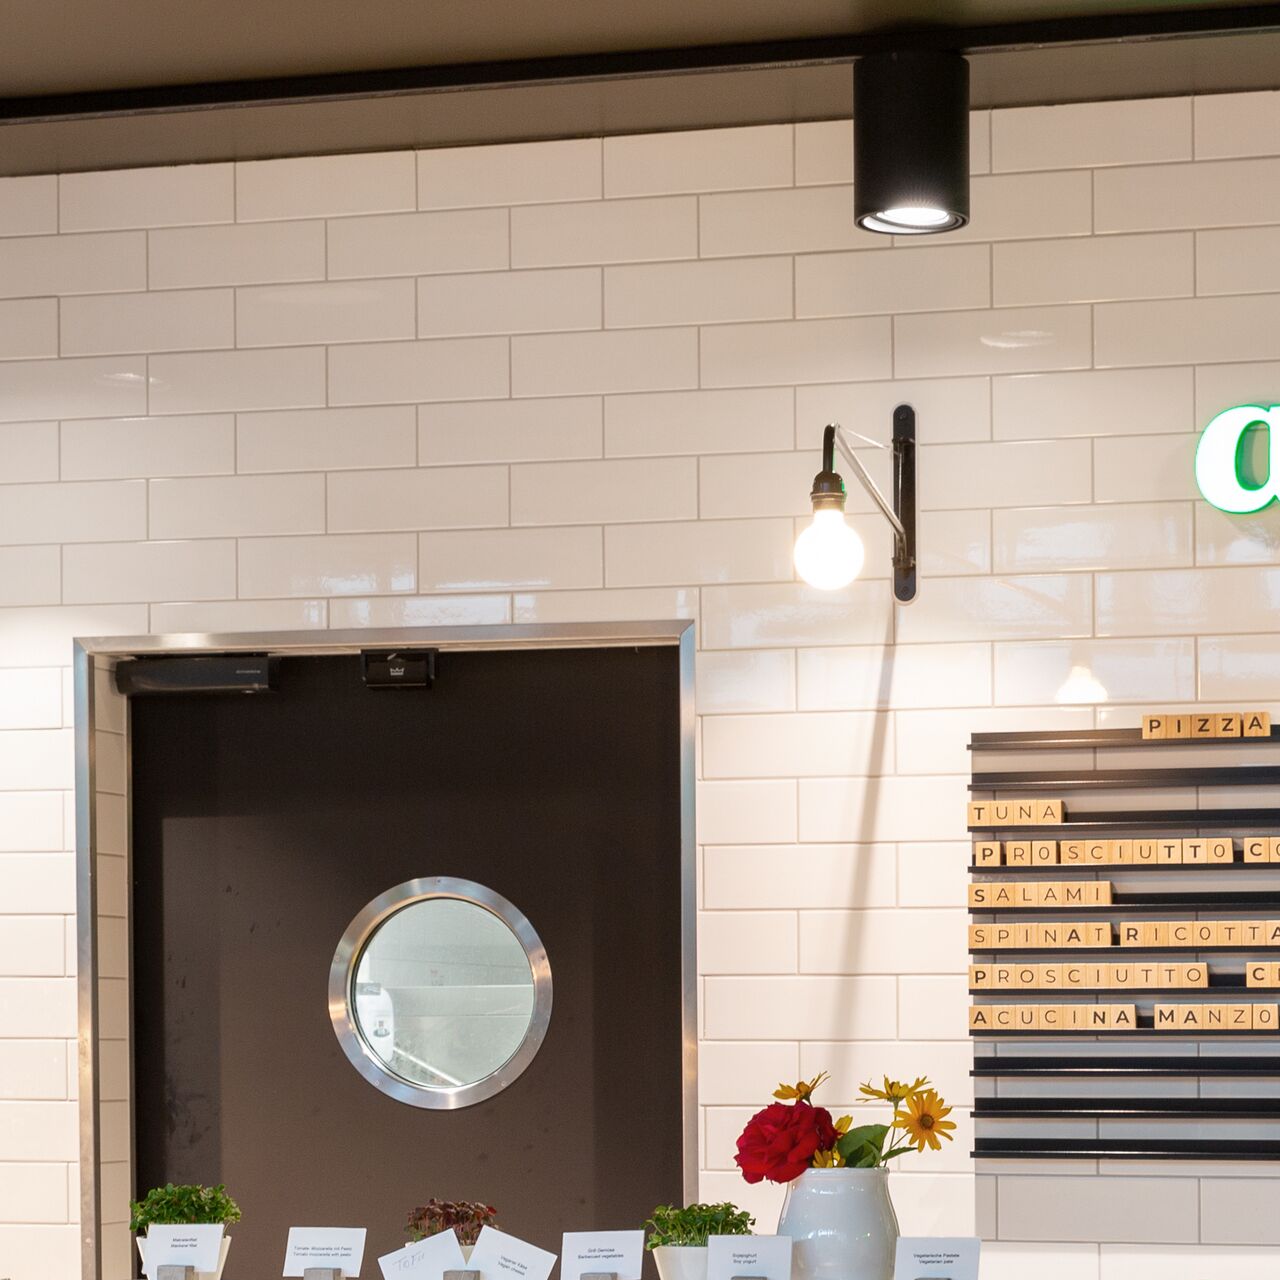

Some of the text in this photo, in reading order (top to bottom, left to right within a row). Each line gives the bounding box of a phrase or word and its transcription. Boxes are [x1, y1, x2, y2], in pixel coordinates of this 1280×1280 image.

[1150, 715, 1263, 734] PIZZA
[974, 805, 1056, 821] TUNA
[982, 843, 1226, 861] PROSCIUTTO
[974, 887, 1099, 902] SALAMI
[974, 927, 1103, 943] SPINAT
[975, 968, 1202, 984] PROSCIUTTO
[974, 1009, 1271, 1025] ACUCINA MANZO
